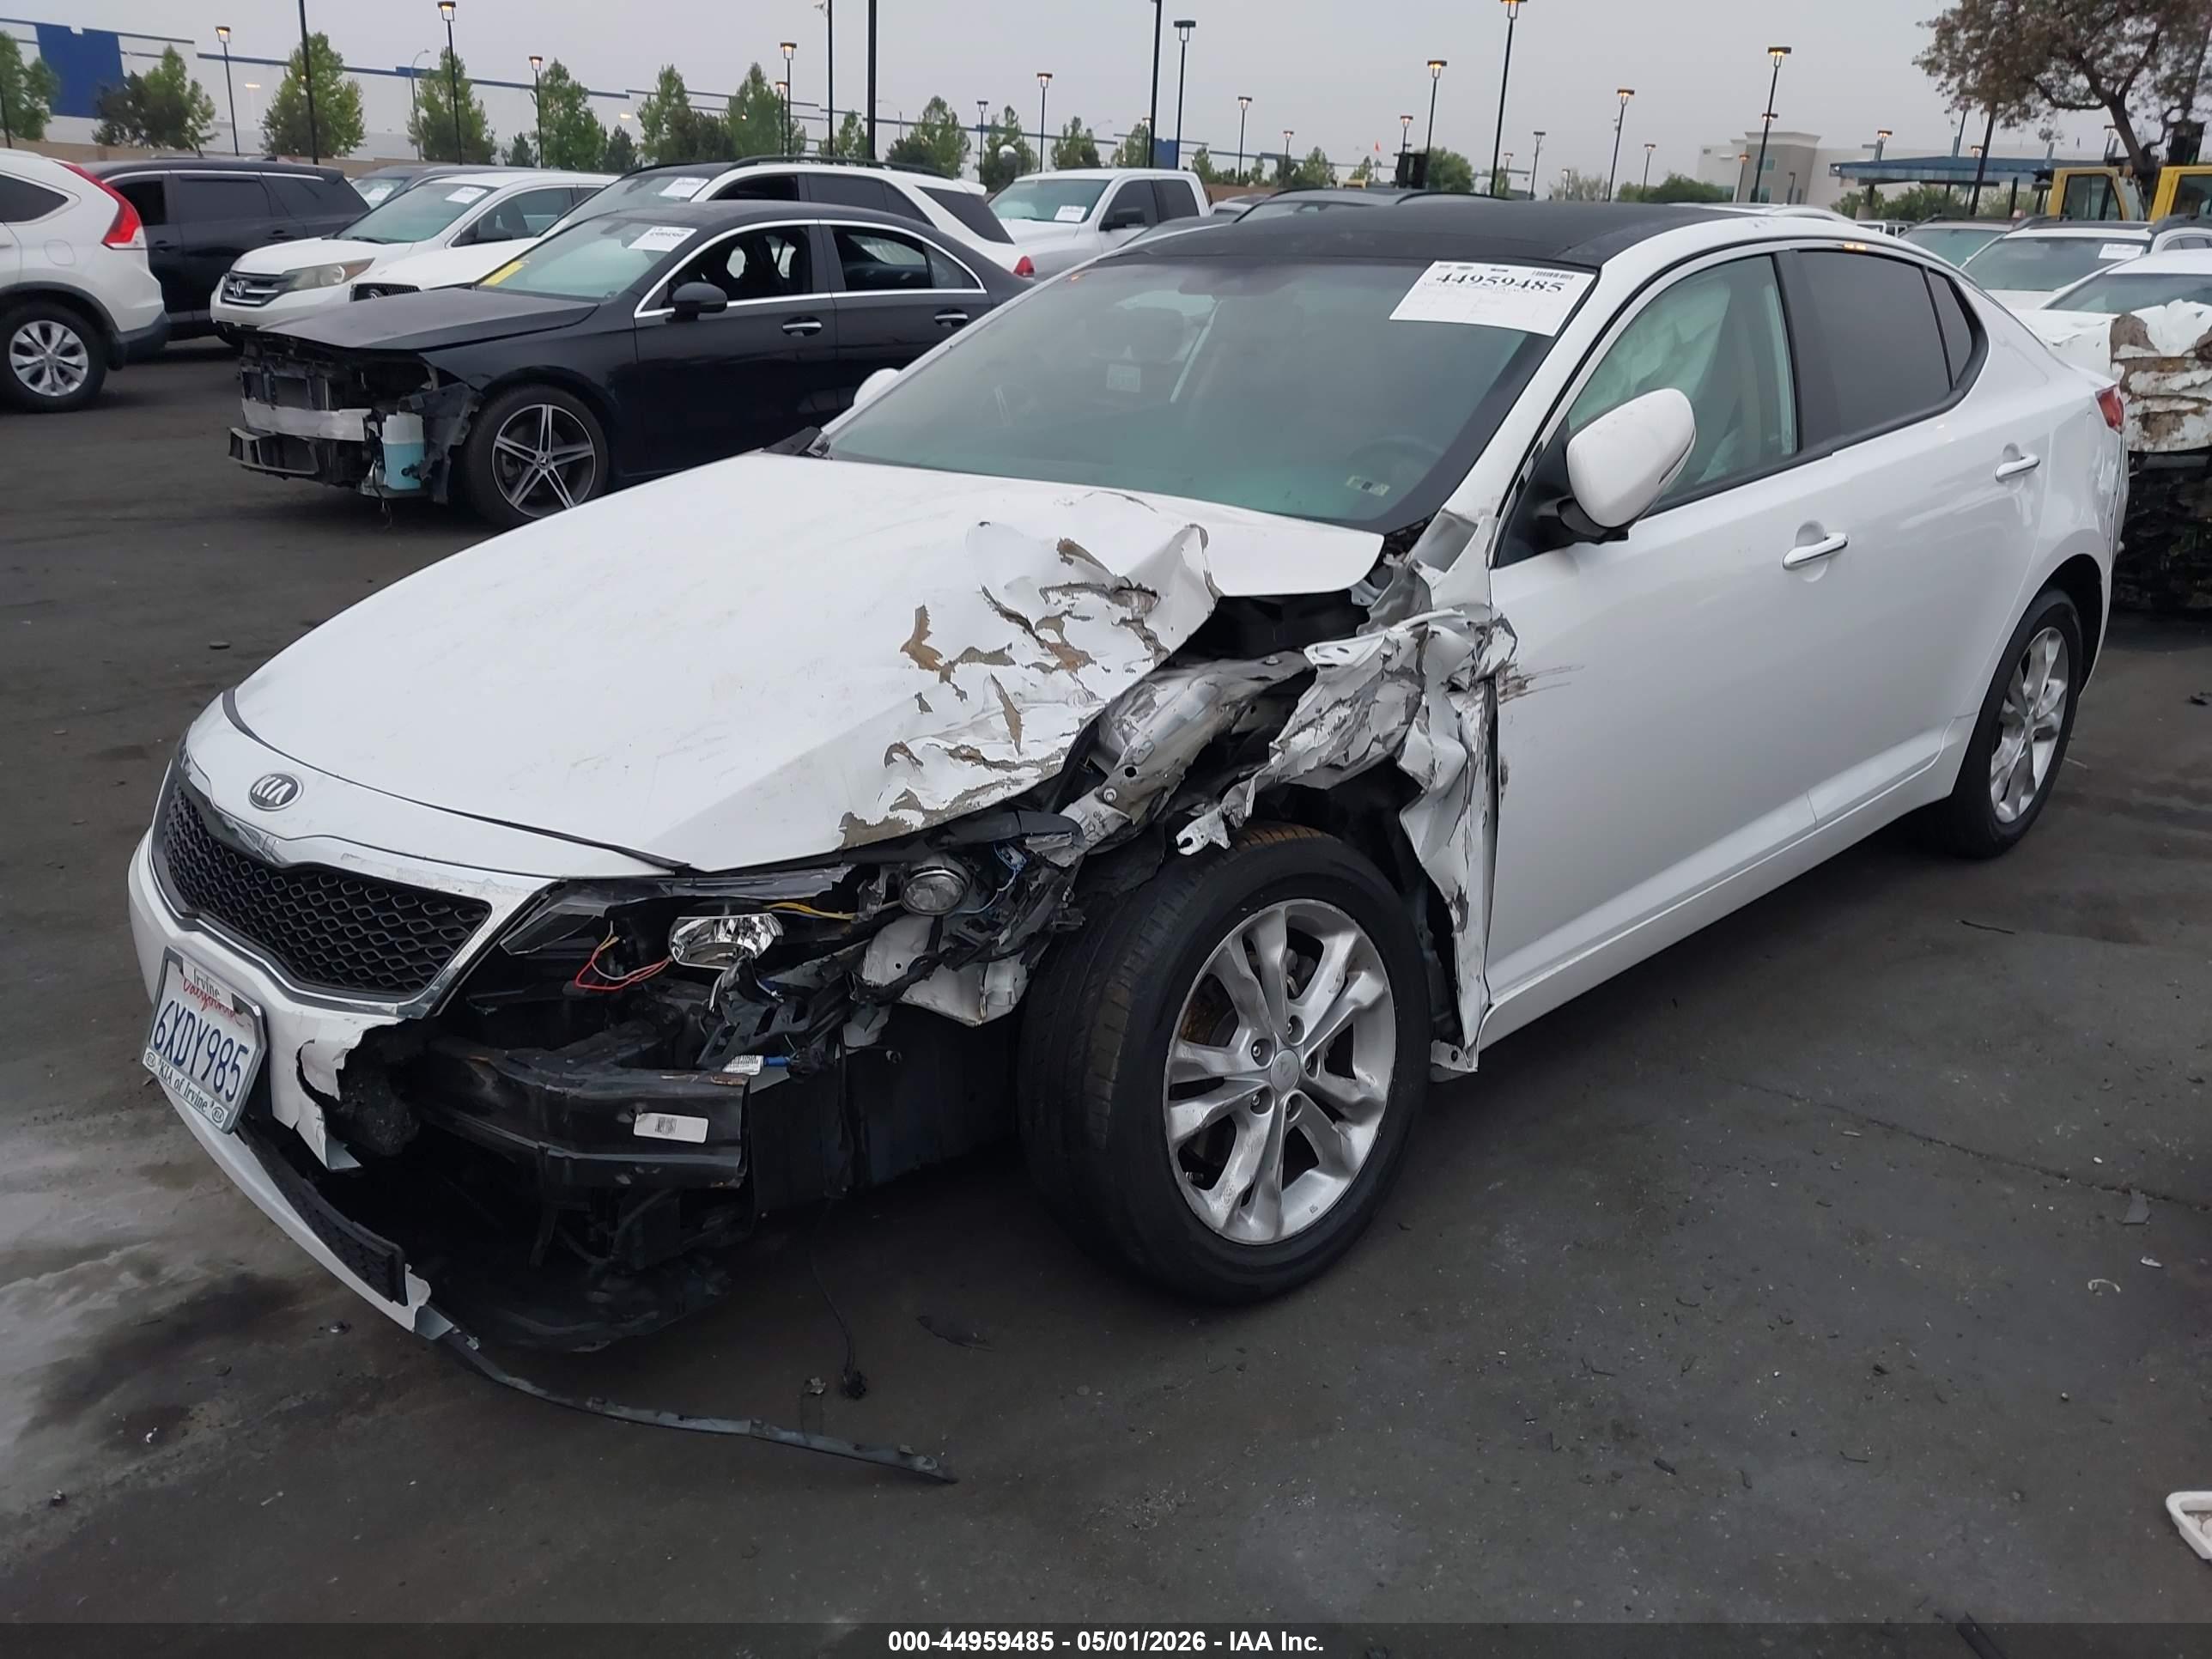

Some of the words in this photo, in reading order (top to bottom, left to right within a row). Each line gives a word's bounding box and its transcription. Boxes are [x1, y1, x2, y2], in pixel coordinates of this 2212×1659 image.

[1435, 272, 1565, 294] 44959485
[251, 775, 292, 805] KIA
[193, 968, 221, 1001] Irvine
[153, 1000, 249, 1102] 6XDY985
[173, 1078, 185, 1091] of
